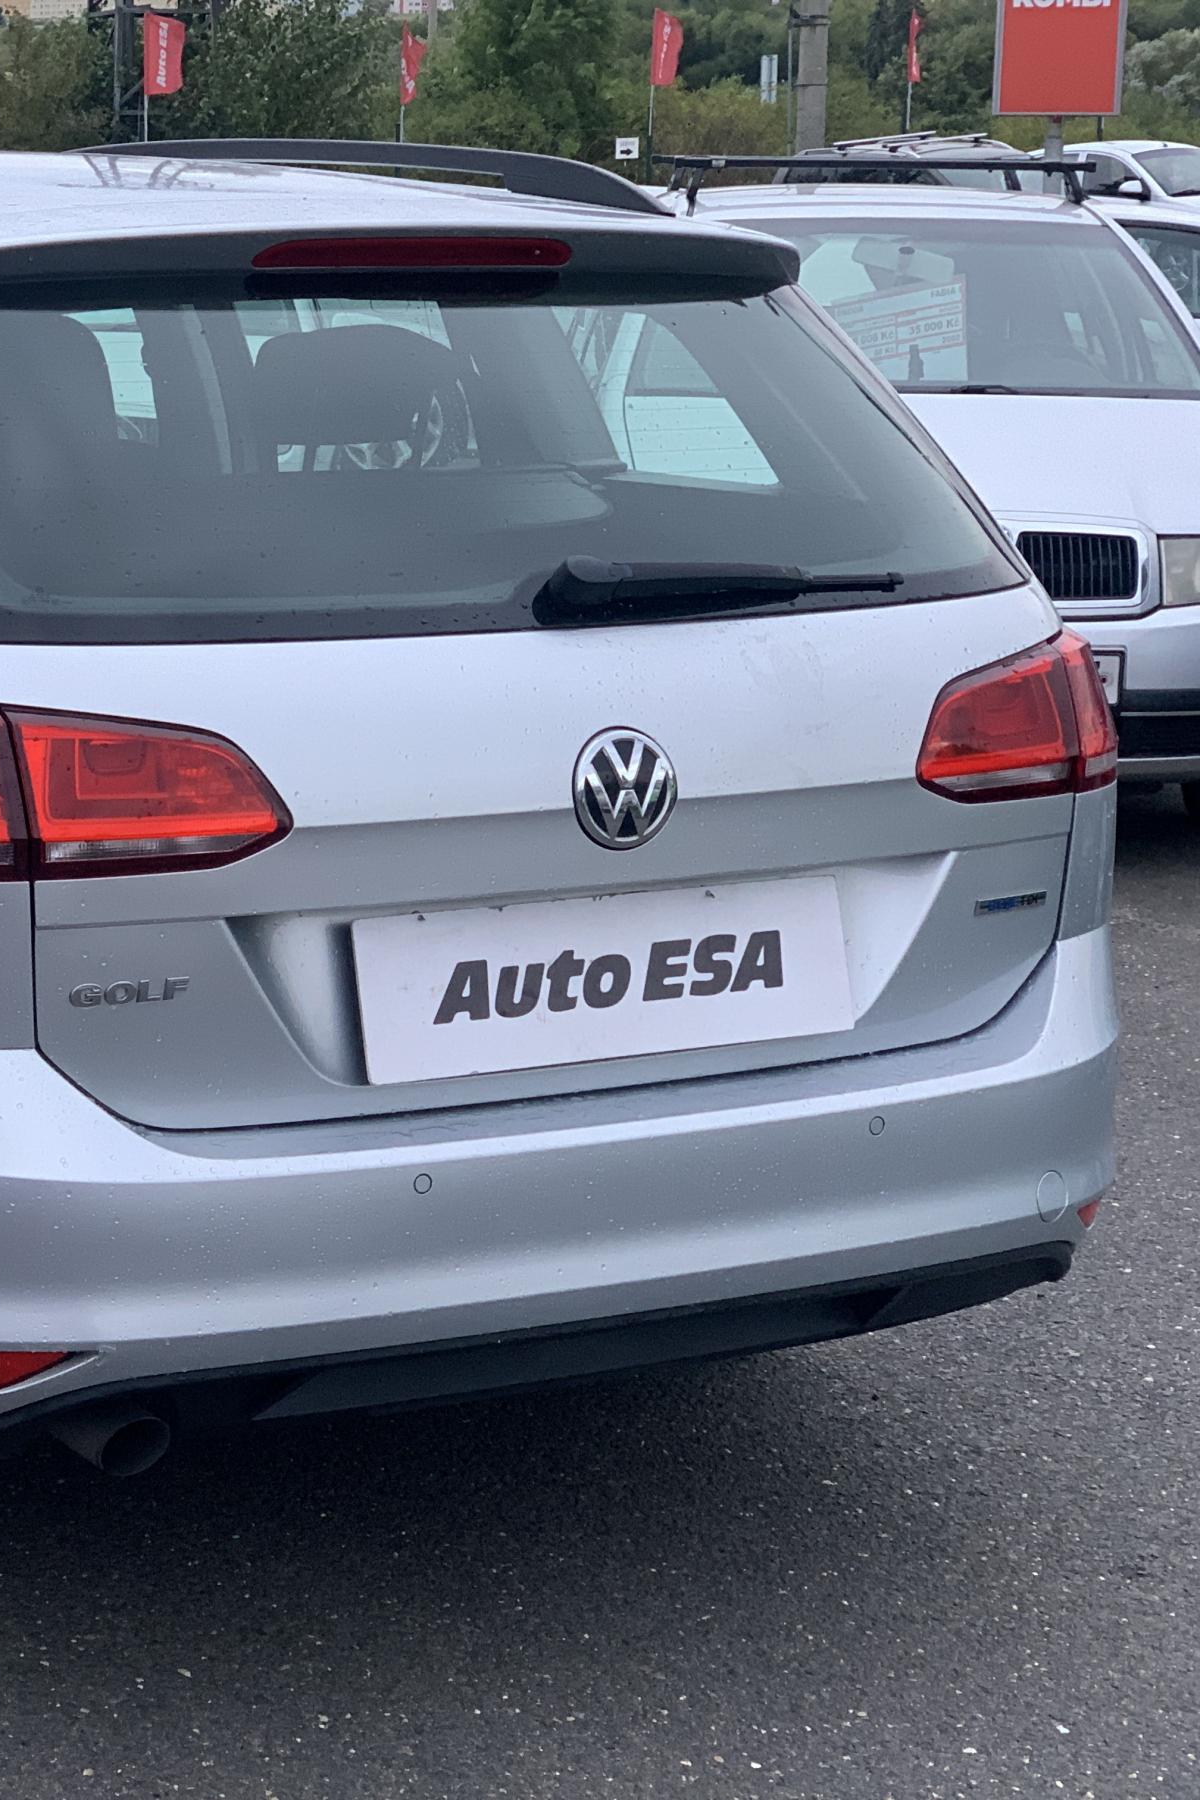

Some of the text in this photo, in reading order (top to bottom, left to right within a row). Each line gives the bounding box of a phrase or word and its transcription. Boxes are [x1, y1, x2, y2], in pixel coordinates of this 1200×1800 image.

[156, 48, 167, 88] Auto
[924, 320, 944, 332] 000
[69, 976, 190, 1008] GOLF
[433, 930, 783, 1025] Auto ESA
